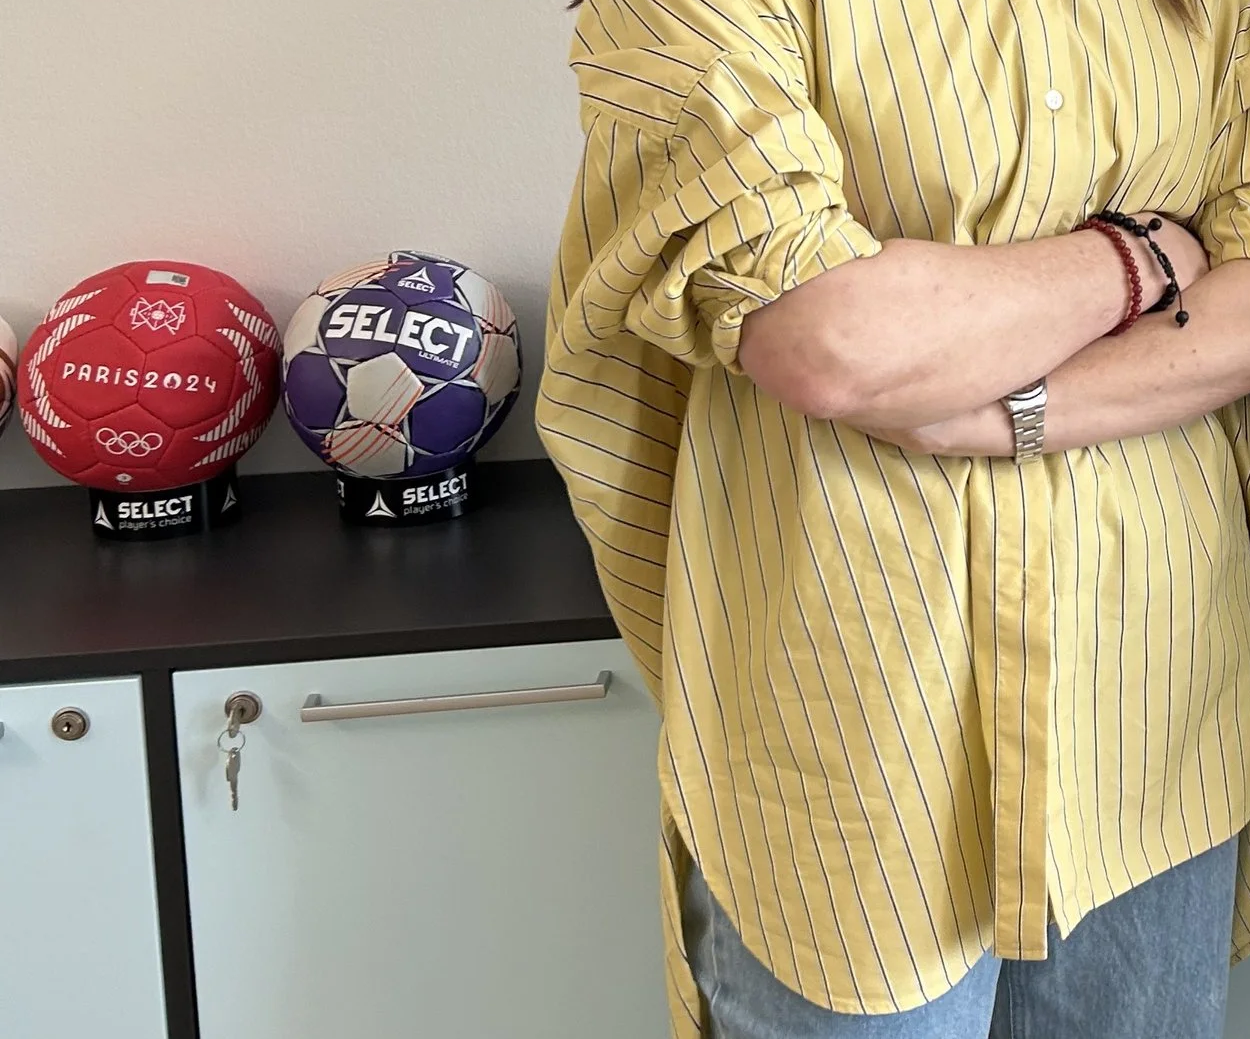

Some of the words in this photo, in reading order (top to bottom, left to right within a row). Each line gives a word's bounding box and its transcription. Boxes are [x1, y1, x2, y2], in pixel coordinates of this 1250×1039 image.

[397, 280, 436, 294] SELECT
[325, 304, 474, 363] SELECT
[418, 350, 460, 369] ULTIMATE
[402, 473, 468, 505] SELECT
[117, 495, 193, 519] SELECT
[403, 502, 442, 516] player's
[118, 519, 157, 531] player's
[158, 514, 192, 528] choice
